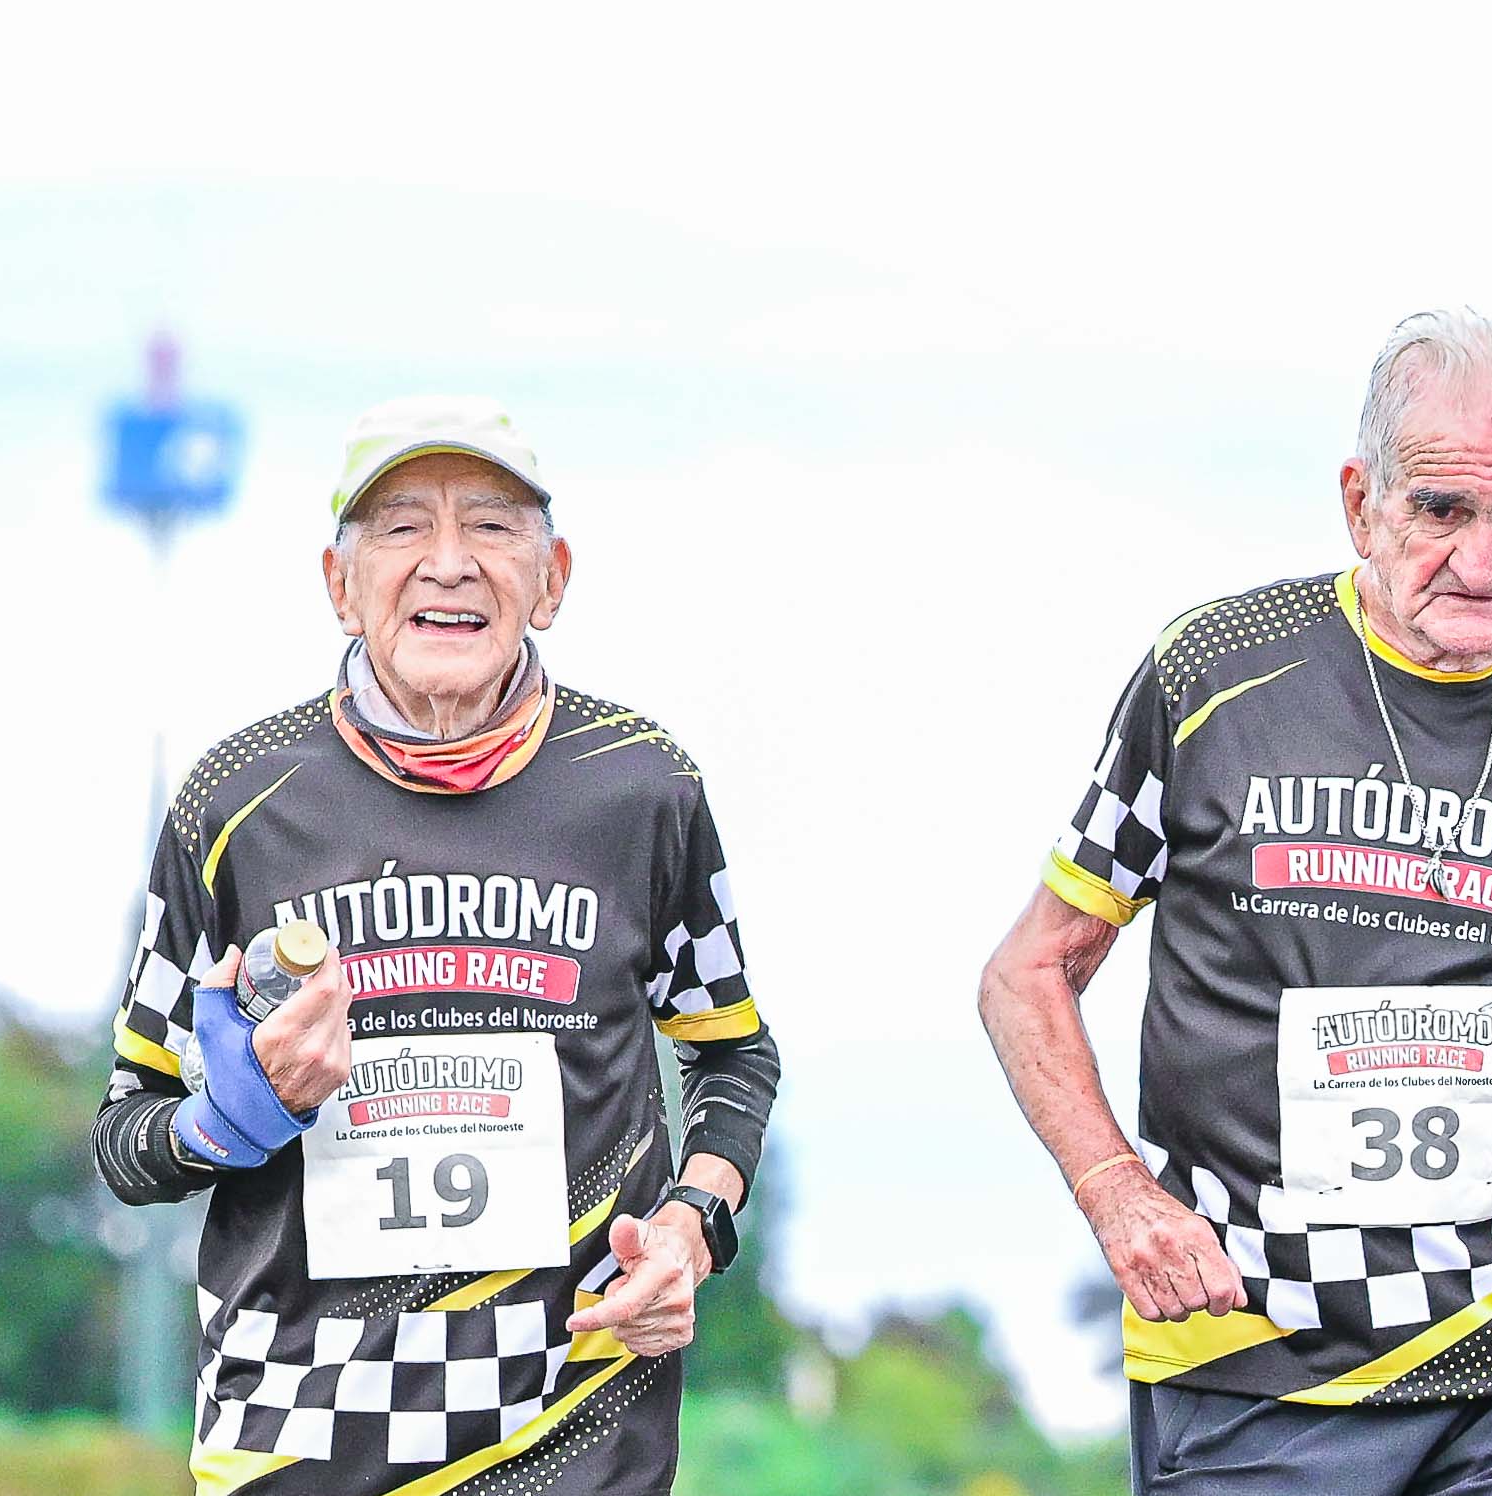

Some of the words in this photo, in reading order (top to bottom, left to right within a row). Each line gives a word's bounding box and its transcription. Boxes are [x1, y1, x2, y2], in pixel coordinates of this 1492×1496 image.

[1287, 849, 1427, 892] RUNNING
[1231, 891, 1248, 912] La
[1250, 894, 1319, 918] Carrera
[1323, 901, 1348, 924] de
[1353, 905, 1380, 928] los
[1384, 911, 1450, 939] Clubes
[1455, 919, 1485, 943] del
[341, 951, 456, 995] UNNING
[466, 951, 548, 996] RACE
[360, 1012, 386, 1030] de
[391, 1009, 416, 1030] los
[420, 1008, 480, 1029] Clubes
[484, 1007, 518, 1029] del
[523, 1011, 598, 1030] Noroeste
[1345, 1046, 1421, 1072] RUNNING
[1426, 1047, 1467, 1069] RACE
[1314, 1079, 1325, 1090] La
[1327, 1079, 1366, 1089] Carrera
[1369, 1078, 1382, 1088] de
[1384, 1077, 1399, 1088] los
[1401, 1076, 1436, 1087] Clubes
[1438, 1076, 1453, 1086] del
[366, 1095, 442, 1121] RUNNING
[446, 1094, 492, 1115] RACE
[335, 1130, 348, 1141] La
[349, 1128, 388, 1140] Carrera
[389, 1126, 403, 1137] de
[405, 1125, 421, 1136] los
[422, 1124, 458, 1135] Clubes
[460, 1122, 477, 1134] del
[478, 1122, 525, 1133] Noroeste
[1351, 1106, 1460, 1181] 38
[376, 1153, 489, 1230] 19
